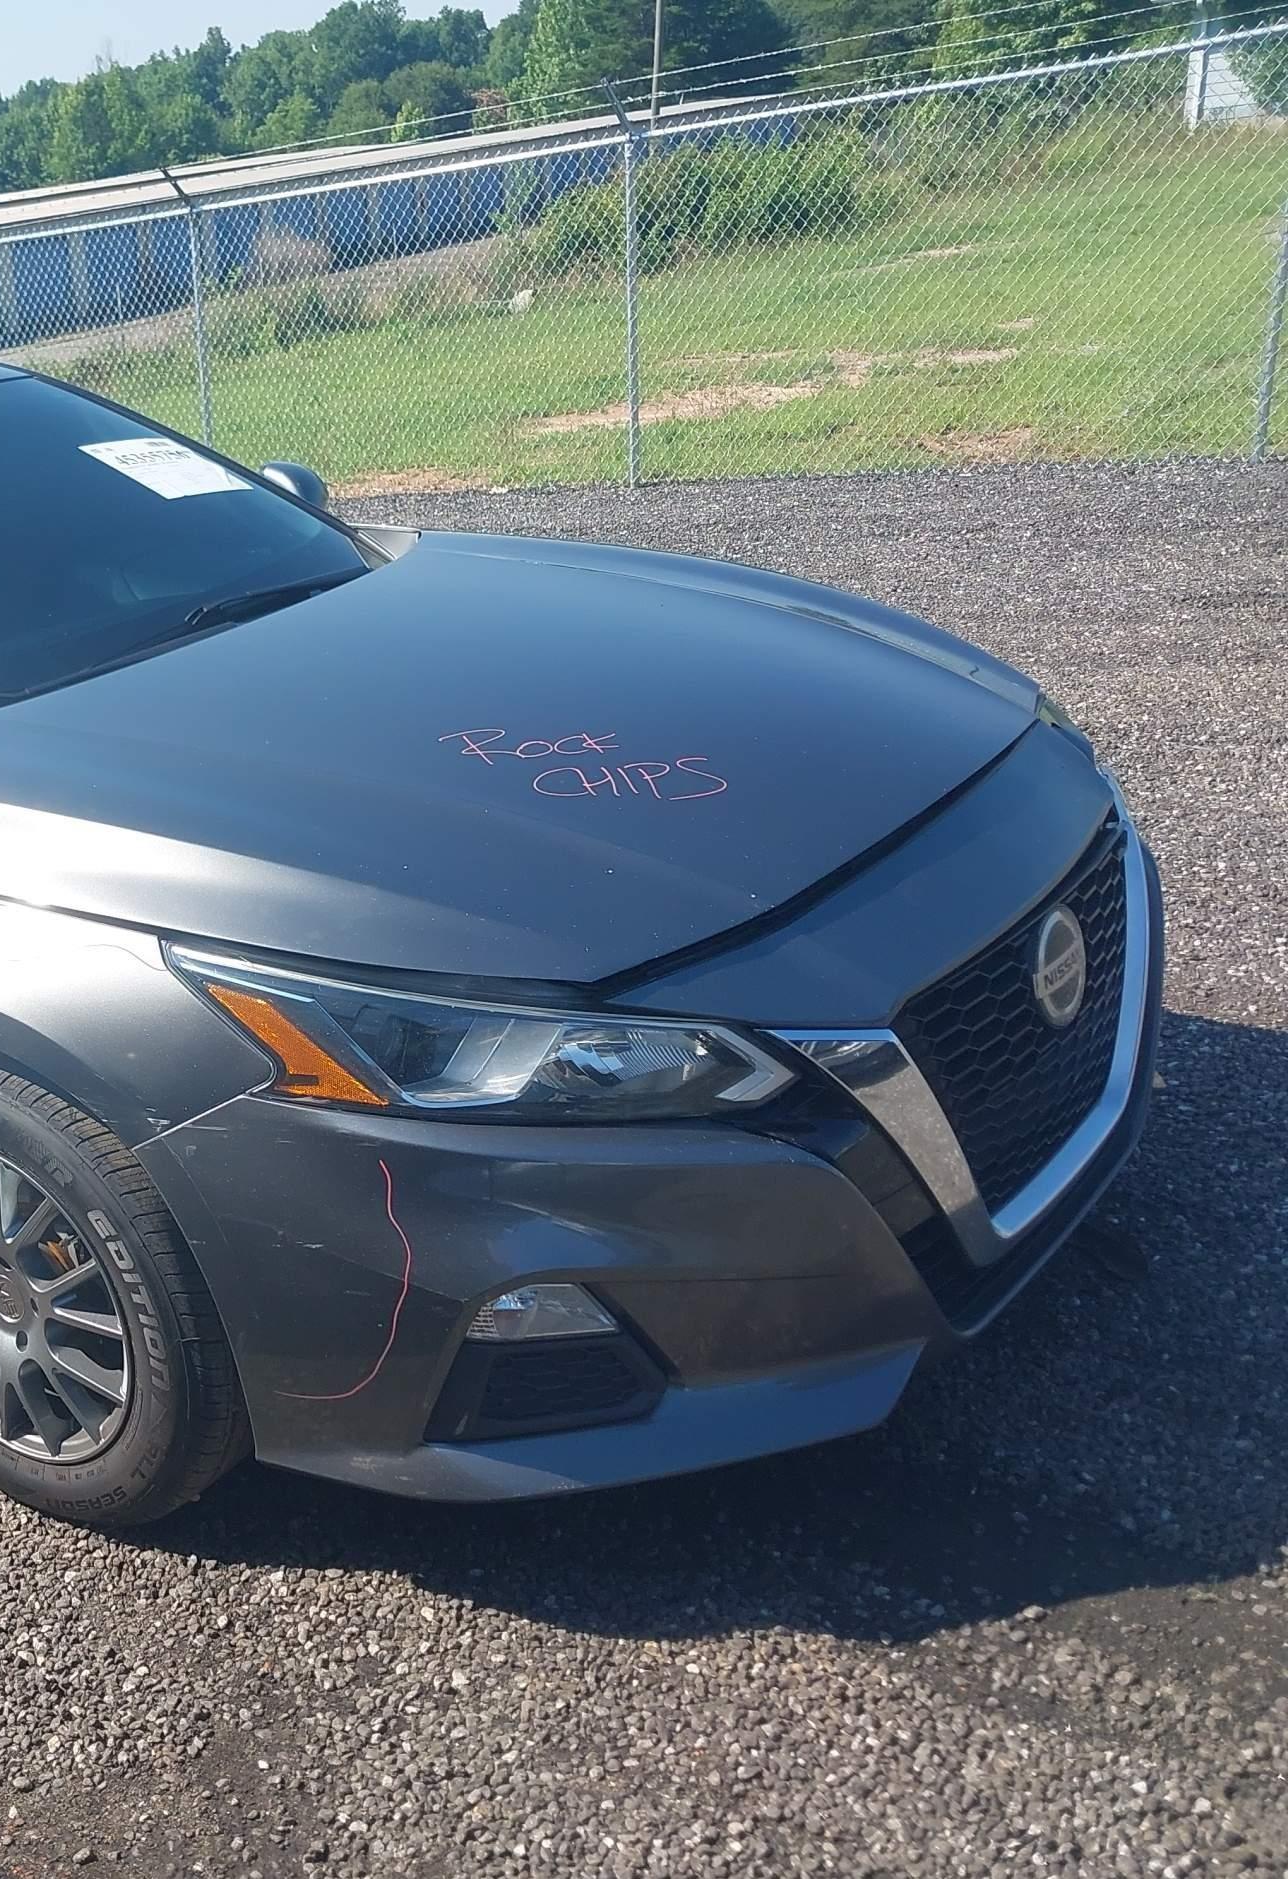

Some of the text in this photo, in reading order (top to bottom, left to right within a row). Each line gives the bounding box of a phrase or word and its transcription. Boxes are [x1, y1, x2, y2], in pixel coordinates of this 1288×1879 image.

[533, 756, 728, 801] CHIPS
[1043, 948, 1081, 990] NISSAN
[86, 1208, 172, 1391] EDITION
[46, 1484, 128, 1514] SEASON
